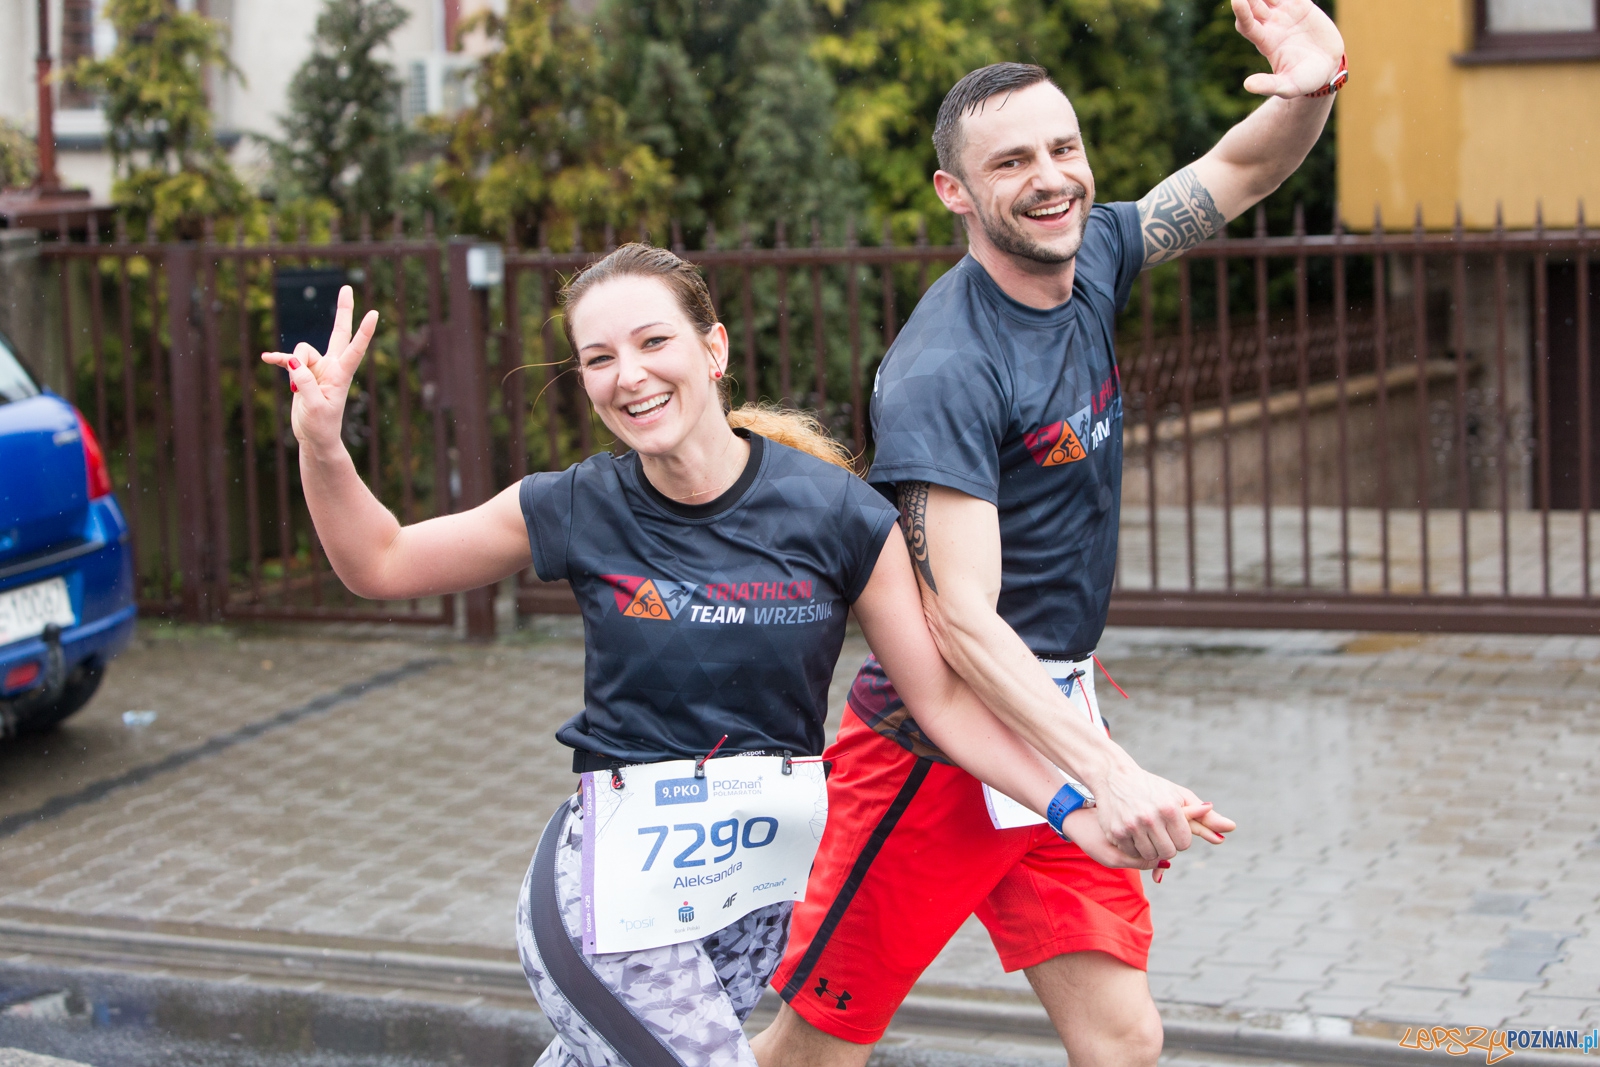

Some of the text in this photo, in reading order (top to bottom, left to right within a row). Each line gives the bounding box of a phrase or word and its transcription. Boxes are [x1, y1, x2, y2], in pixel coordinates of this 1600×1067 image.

[705, 580, 812, 601] TRIATHLON
[690, 598, 833, 625] TEAM WRZEŚNIA
[673, 784, 700, 796] PKO
[637, 816, 779, 872] 7290
[673, 861, 743, 889] Aleksandra
